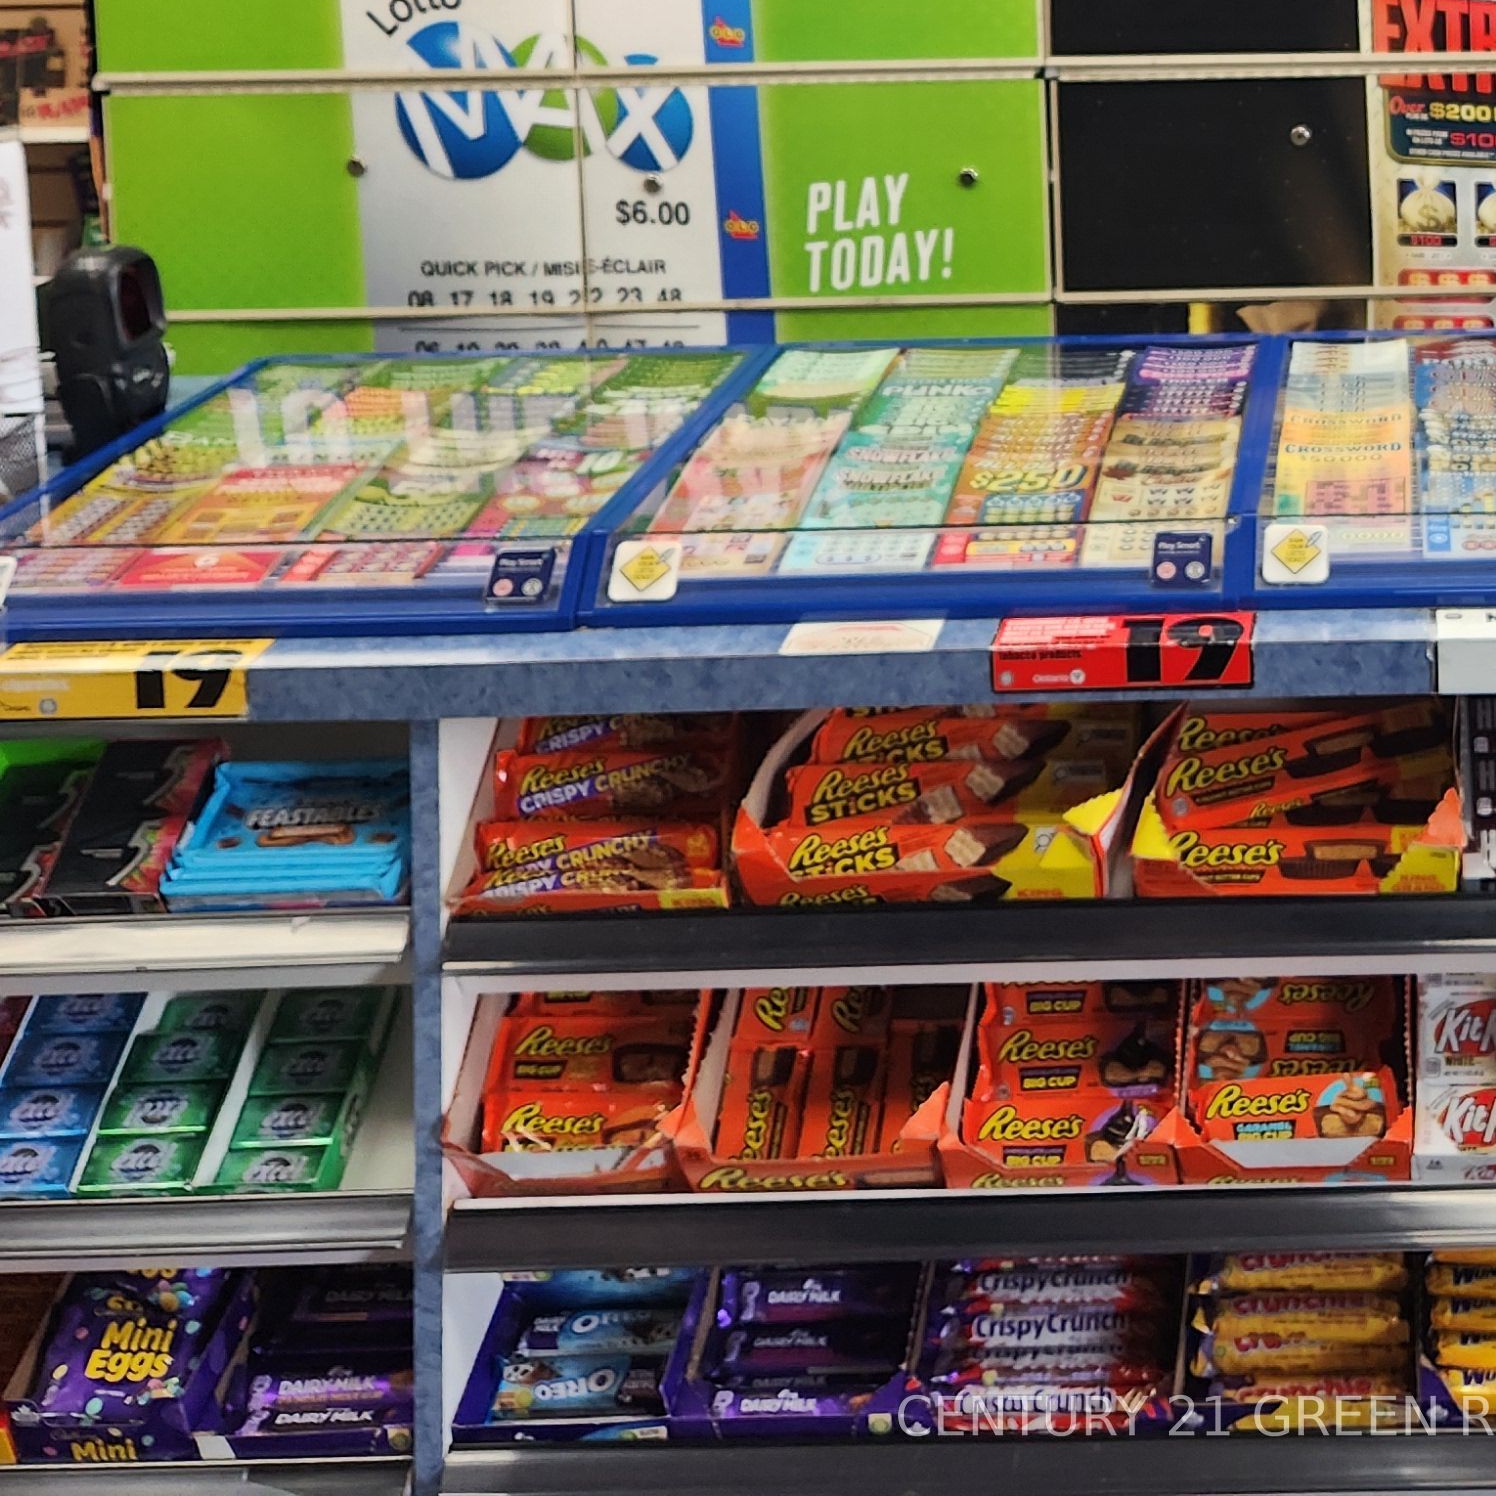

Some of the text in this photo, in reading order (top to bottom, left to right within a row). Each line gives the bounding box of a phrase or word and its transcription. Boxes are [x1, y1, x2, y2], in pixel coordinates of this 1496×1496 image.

[396, 26, 693, 179] MAX
[615, 199, 691, 228] $6.00
[807, 173, 910, 235] PLAY
[420, 261, 478, 277] QUICK
[484, 261, 526, 277] PICK
[807, 227, 955, 294] TODAY!
[1285, 442, 1402, 453] CROSSWORD
[967, 464, 1090, 493] $250
[1123, 617, 1244, 682] 19
[135, 650, 245, 709] 19
[519, 754, 691, 814] CRISPY CRUNCHY
[1166, 748, 1288, 798] Reese's
[789, 826, 890, 870] Reese's
[999, 1029, 1100, 1063] Reese's
[502, 1102, 605, 1135] Reese's
[1205, 1084, 1312, 1119] Reese's
[978, 1106, 1085, 1142] Reese's
[101, 1317, 178, 1352] Mini
[85, 1349, 174, 1382] Eggs
[72, 1439, 138, 1461] Mini
